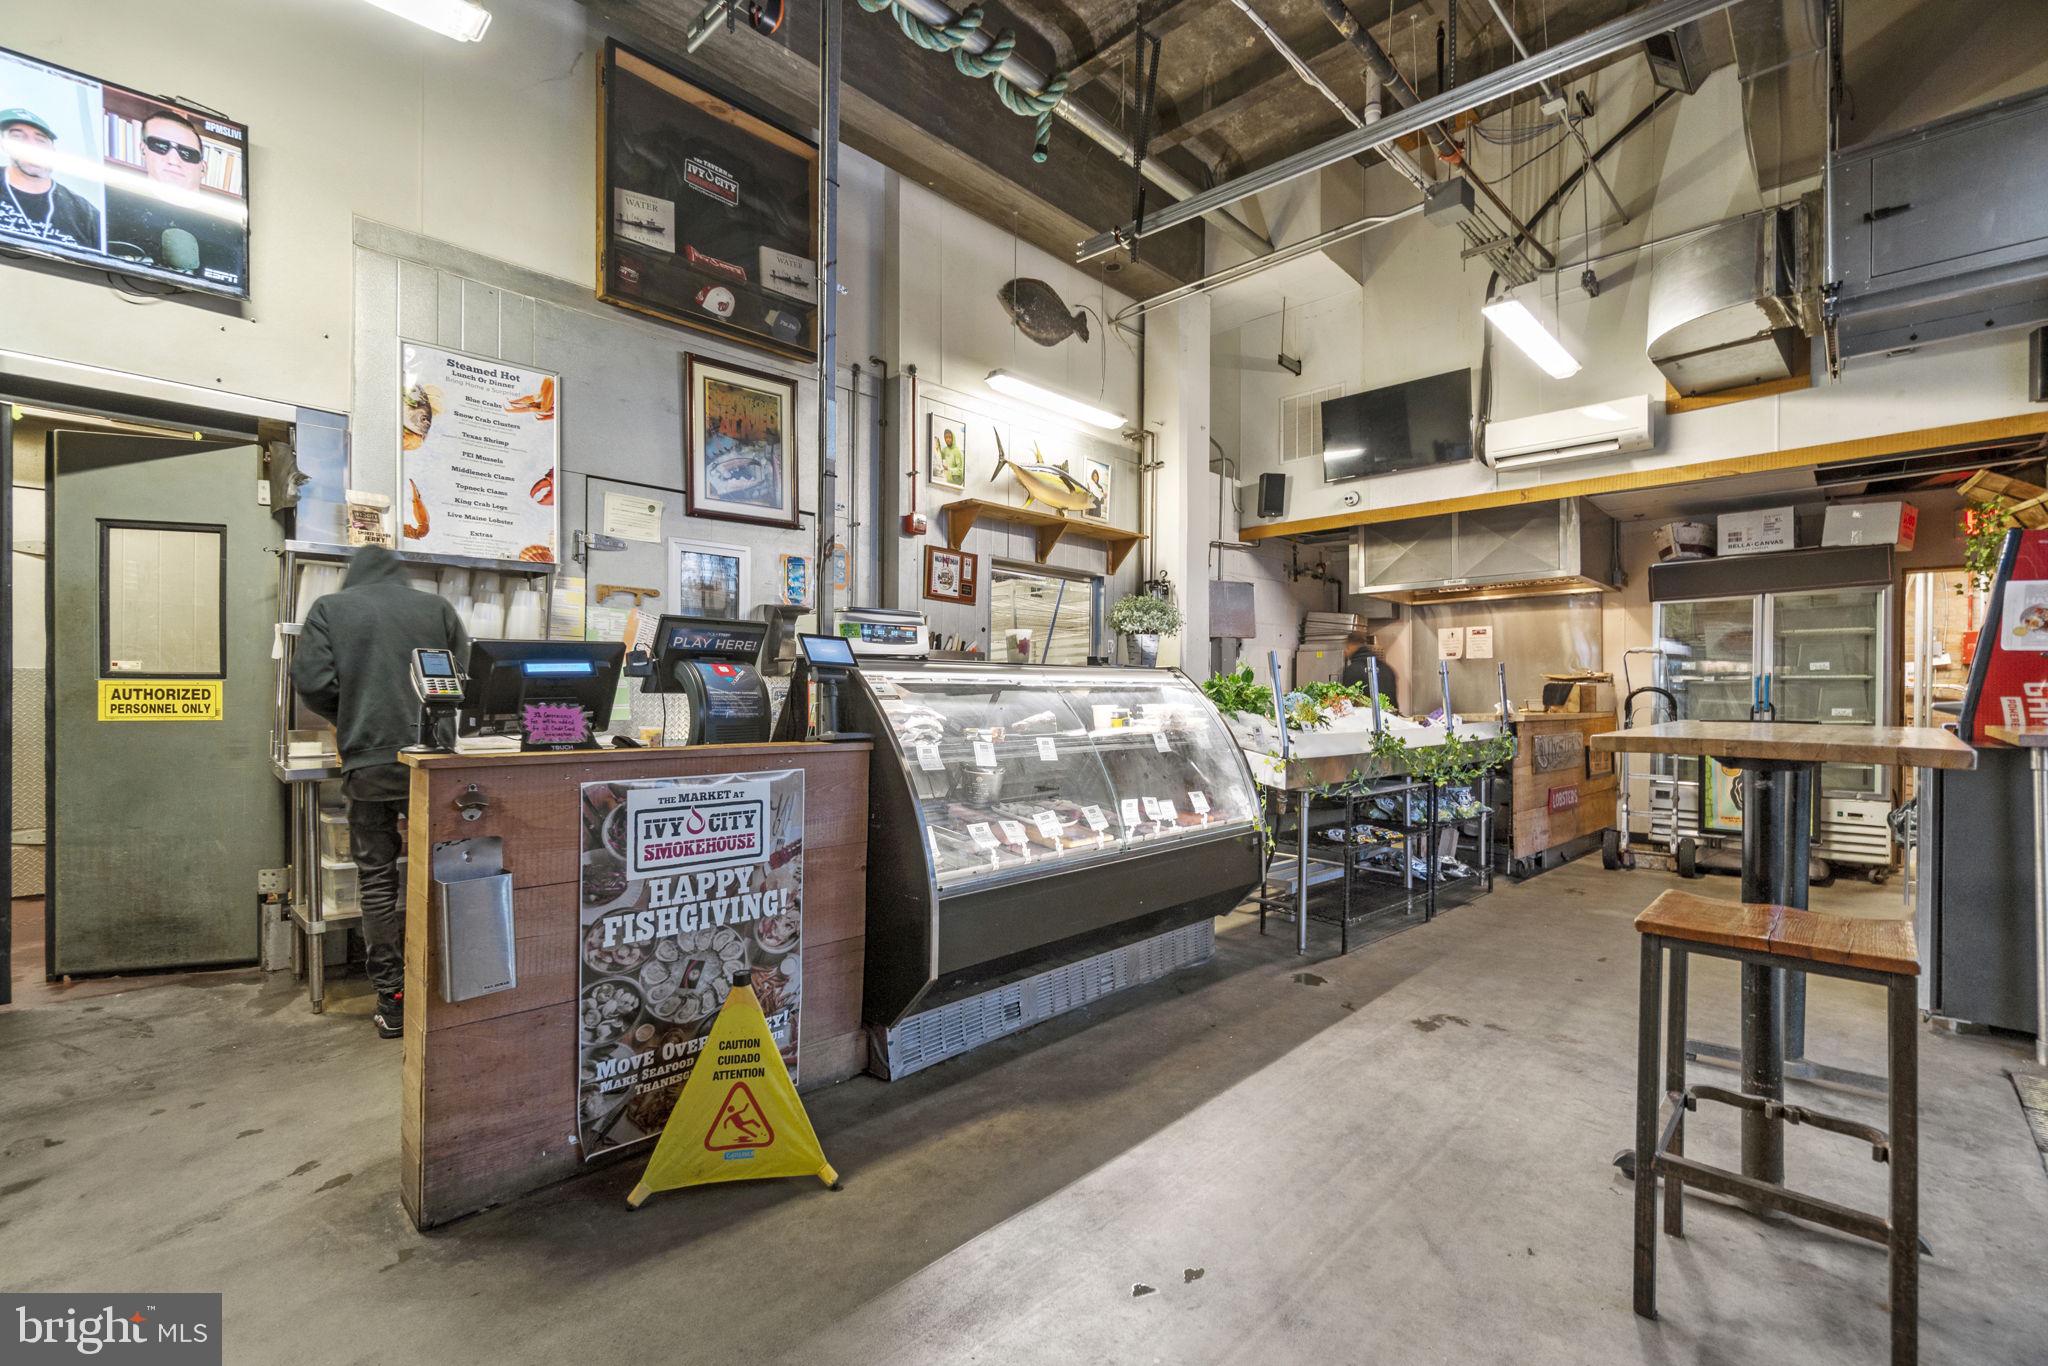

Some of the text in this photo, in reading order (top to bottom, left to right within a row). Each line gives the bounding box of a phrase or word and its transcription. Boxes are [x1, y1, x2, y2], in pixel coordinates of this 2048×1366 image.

[688, 163, 705, 178] IVY
[714, 176, 737, 192] CITY
[625, 197, 658, 212] WATER
[204, 268, 238, 284] ESPN
[446, 358, 520, 382] Steamed Hot
[446, 376, 464, 386] Bring
[465, 380, 484, 390] Home
[452, 370, 476, 381] Lunch
[489, 379, 515, 389] Dinner
[482, 400, 502, 409] Crabs
[454, 410, 520, 430] Snow Crab Clusters
[462, 432, 509, 446] Texas Shrimp
[475, 454, 504, 464] Mussels
[451, 466, 492, 478] Middleneck
[456, 483, 485, 492] Topneck
[454, 498, 472, 506] King
[489, 515, 514, 525] Lobster
[673, 636, 757, 651] PLAY HERE!
[111, 688, 211, 700] AUTHORIZED
[110, 703, 211, 714] PERSONNEL ONLY
[658, 796, 676, 805] THE
[678, 790, 732, 803] MARKET
[1552, 790, 1578, 809] LOBSTERS
[643, 810, 757, 840] IVY CITY
[644, 833, 756, 862] SMOKEHOUSE
[648, 866, 755, 909] HAPPY
[602, 887, 788, 948] FISHGIVING!
[719, 1038, 760, 1050] CAUTION
[718, 1053, 760, 1066] CUIDADO
[635, 1069, 691, 1095] THANKSG
[712, 1068, 765, 1081] ATTENTION
